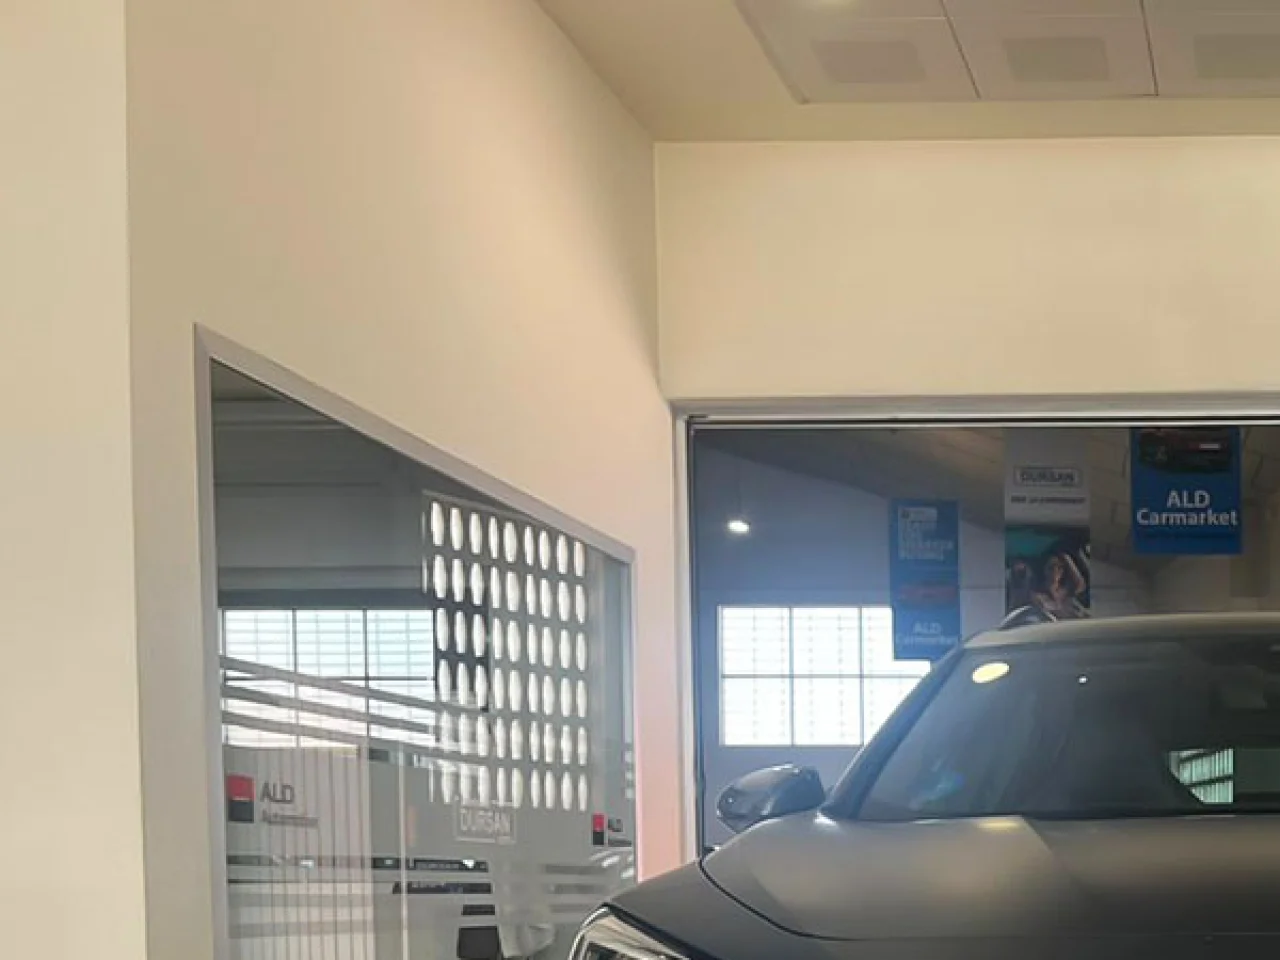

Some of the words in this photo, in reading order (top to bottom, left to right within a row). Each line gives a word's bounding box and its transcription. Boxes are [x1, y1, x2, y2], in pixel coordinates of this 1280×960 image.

[1166, 490, 1211, 509] ALD
[1136, 508, 1239, 526] Carmarket
[260, 781, 295, 804] ALD
